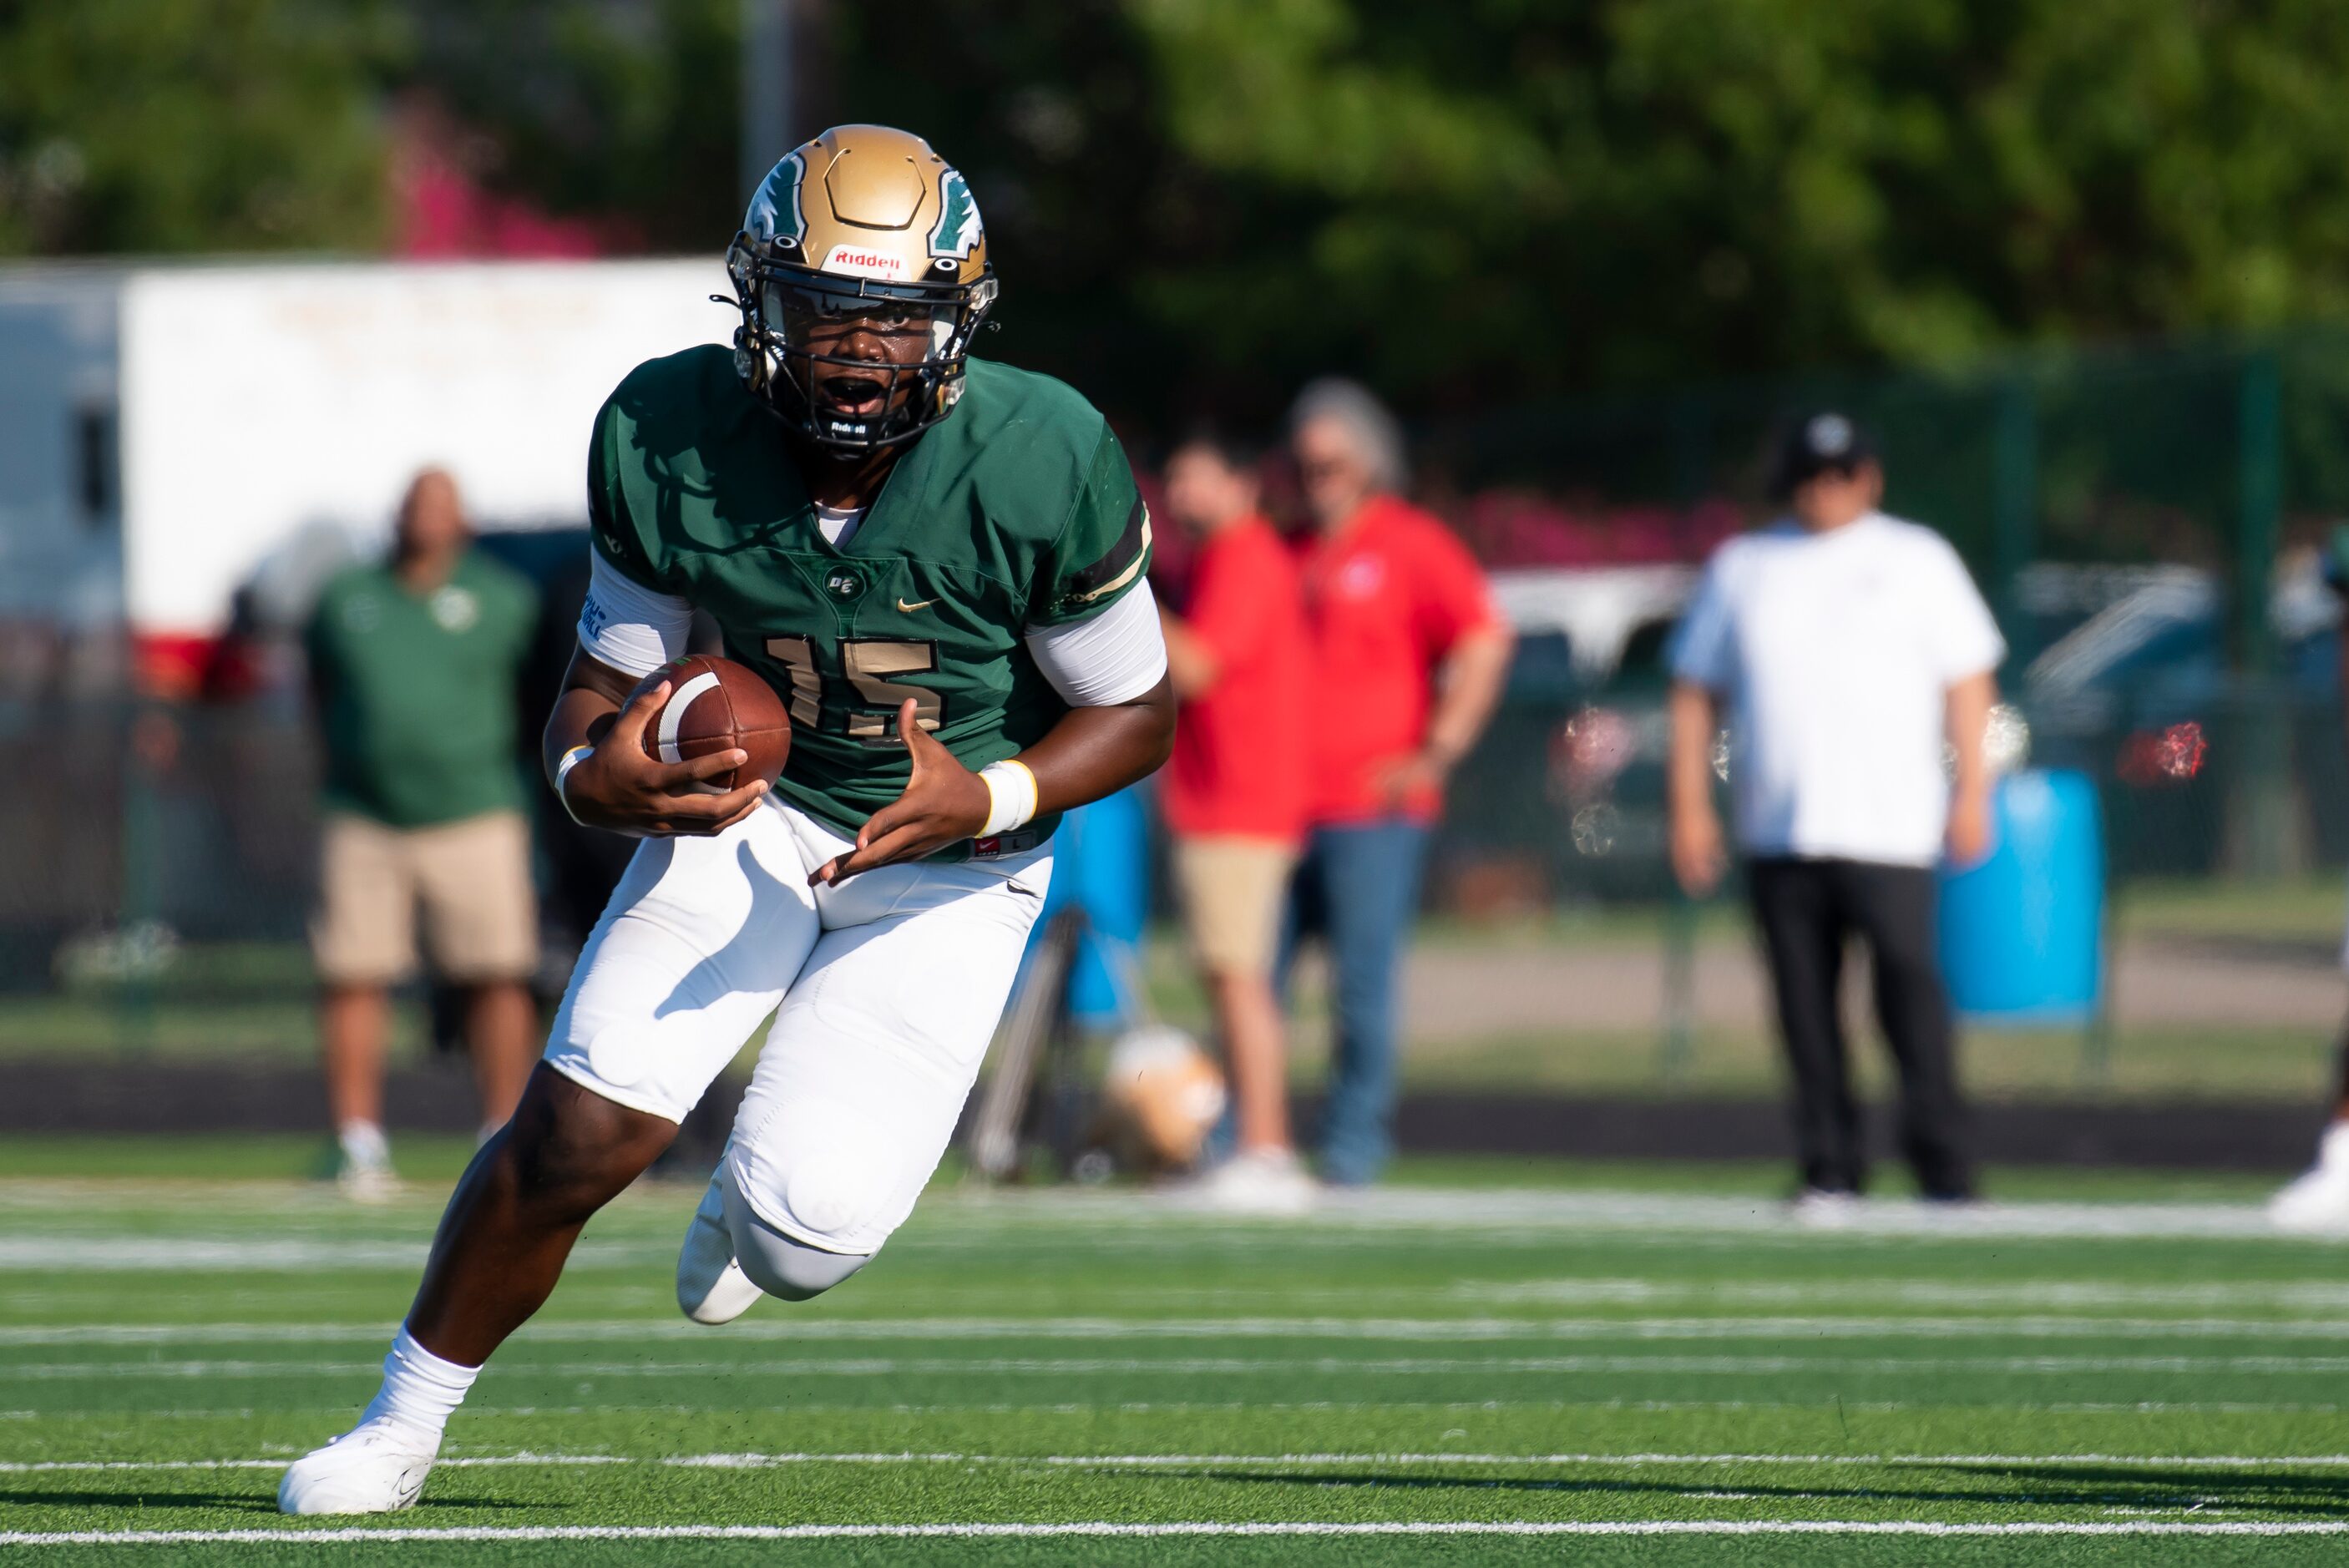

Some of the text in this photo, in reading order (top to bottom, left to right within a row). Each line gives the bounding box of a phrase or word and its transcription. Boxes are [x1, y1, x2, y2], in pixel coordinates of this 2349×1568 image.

[835, 250, 899, 270] Riddell
[762, 635, 949, 747] 15
[1012, 838, 1020, 849] L
